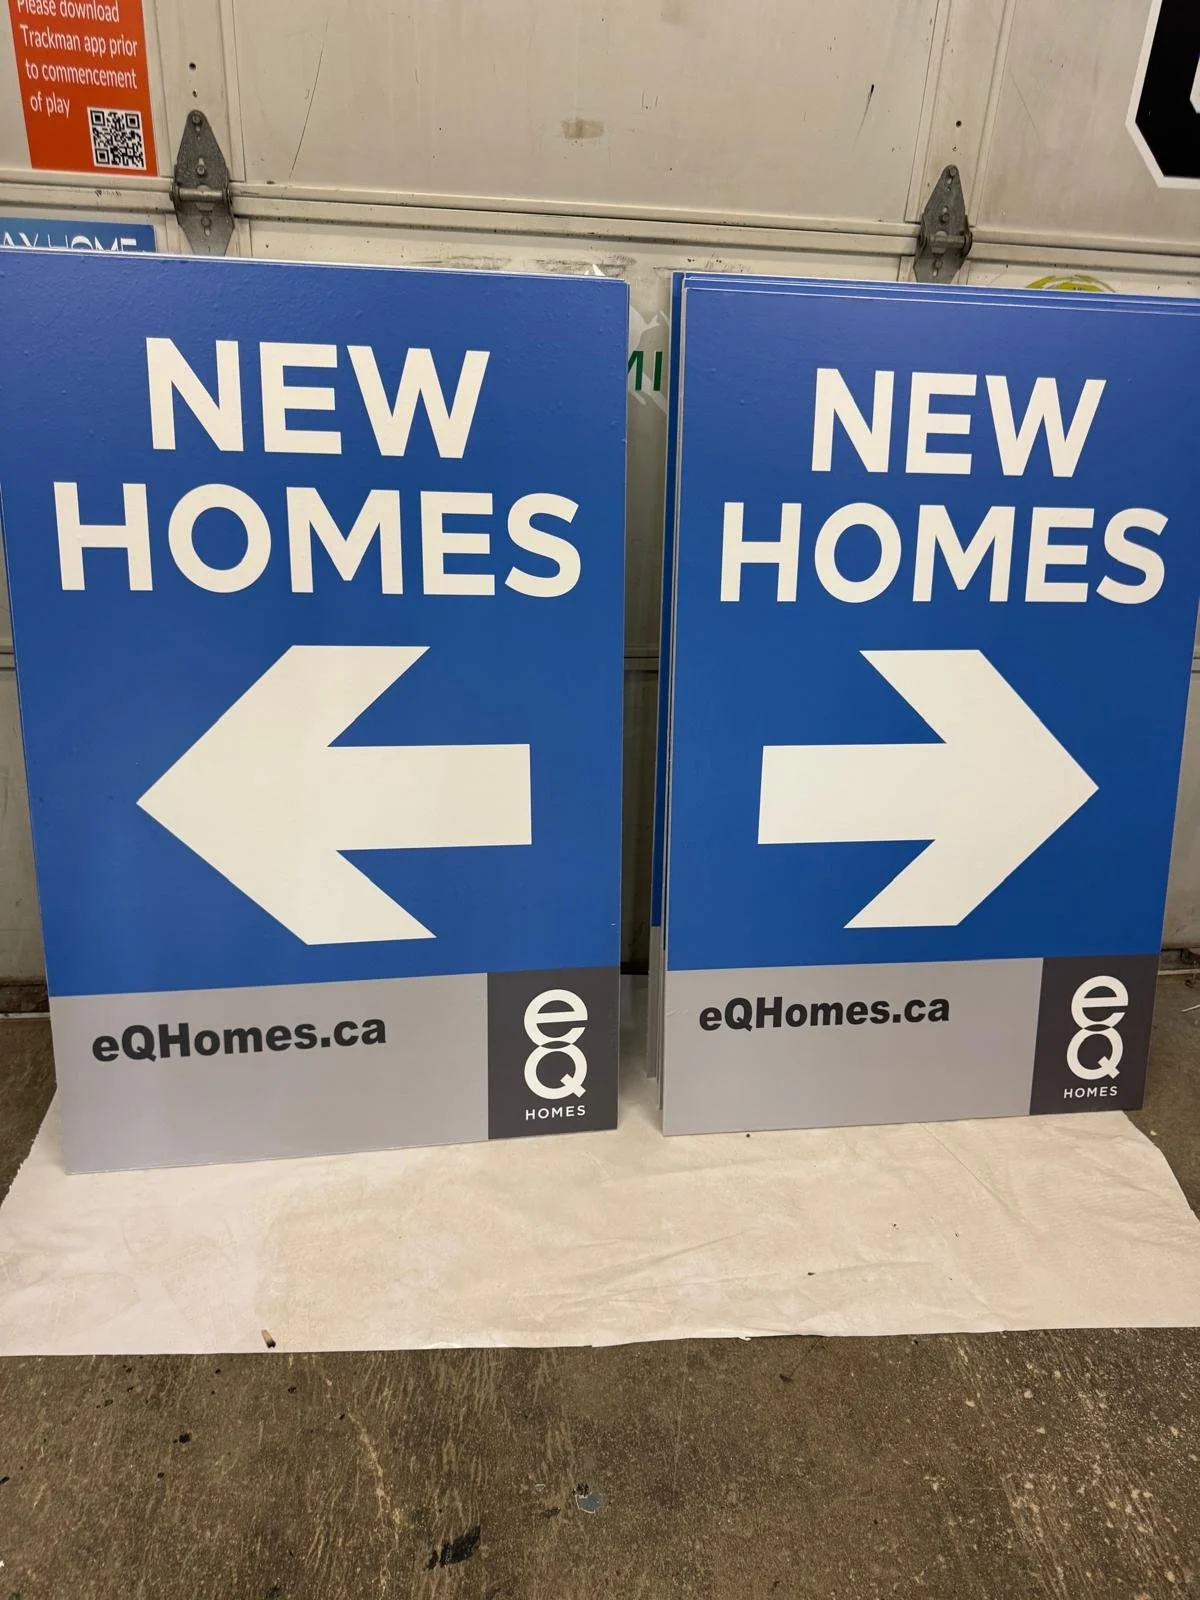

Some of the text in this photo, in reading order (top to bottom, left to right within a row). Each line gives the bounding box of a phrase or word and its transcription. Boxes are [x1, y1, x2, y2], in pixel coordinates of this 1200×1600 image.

[16, 0, 120, 23] Please download
[20, 24, 138, 58] Trackman app prior
[25, 60, 138, 89] to commencement
[30, 91, 70, 118] of play
[146, 337, 490, 458] NEW
[812, 368, 1106, 477] NEW
[54, 482, 581, 598] HOMES
[721, 502, 1168, 604] HOMES
[700, 996, 949, 1031] eQHomes.ca
[92, 1018, 386, 1062] eQHomes.ca
[1064, 1085, 1117, 1098] HOMES
[525, 1105, 586, 1120] HOMES
